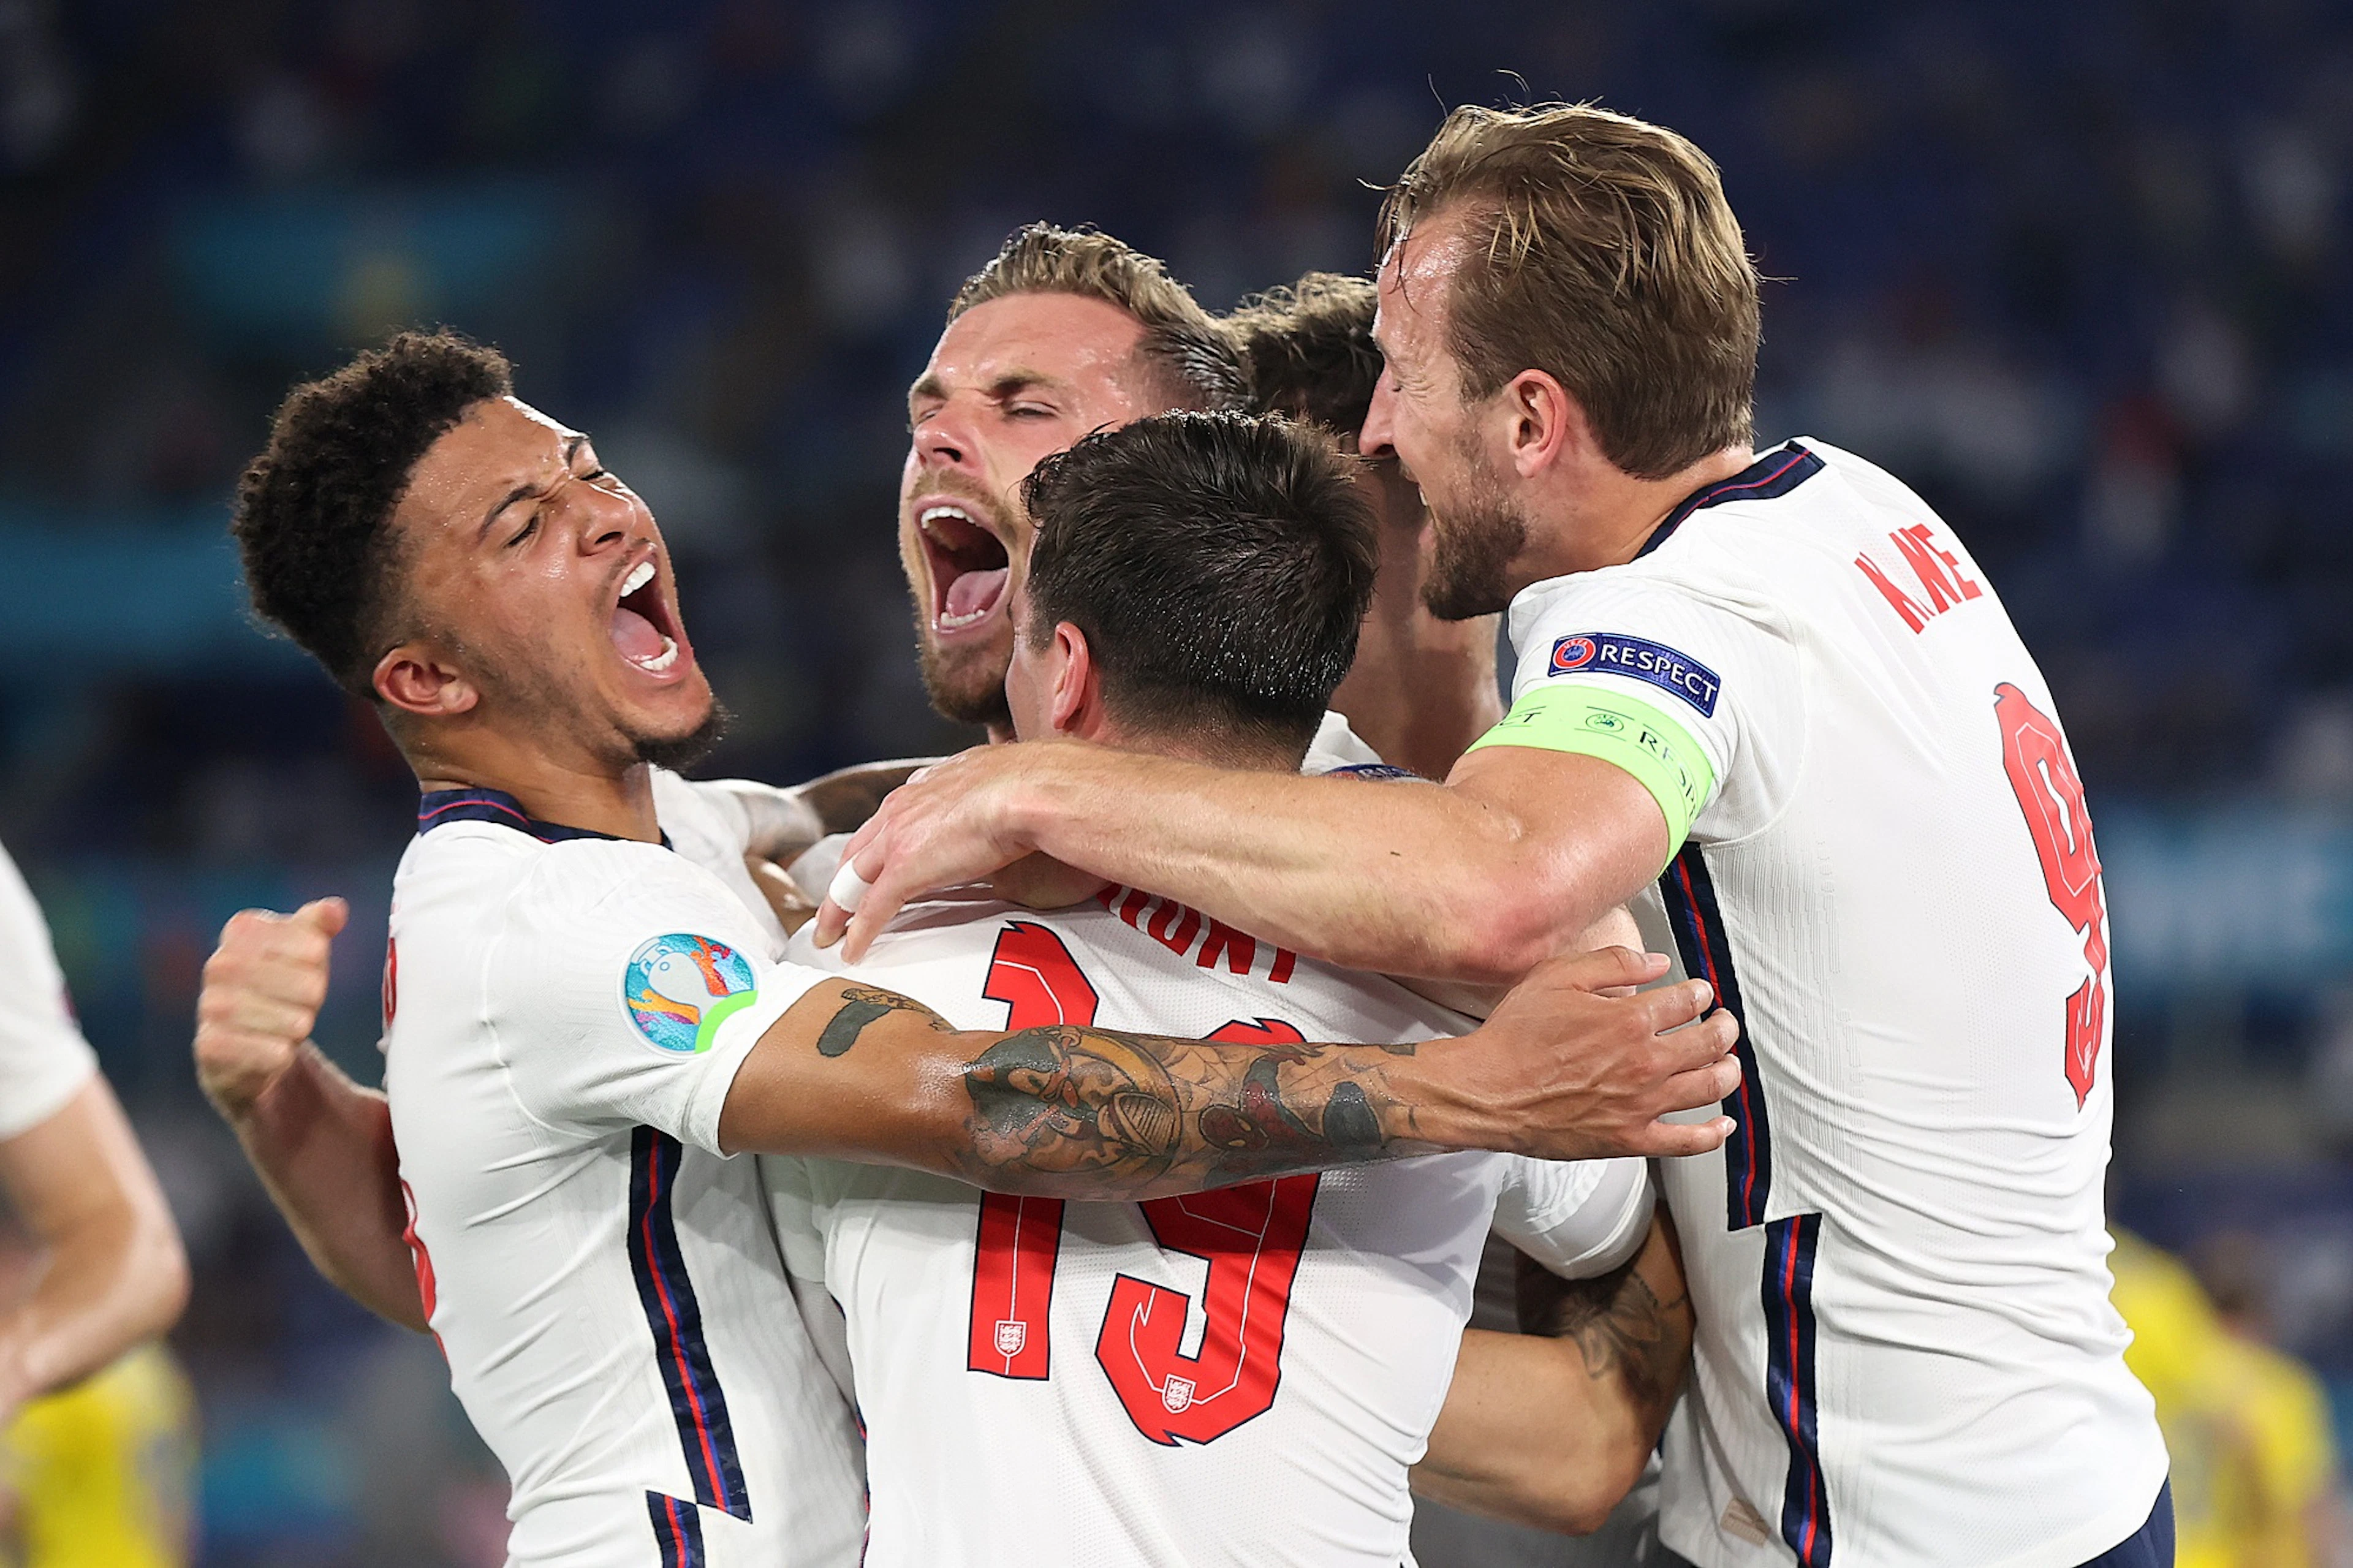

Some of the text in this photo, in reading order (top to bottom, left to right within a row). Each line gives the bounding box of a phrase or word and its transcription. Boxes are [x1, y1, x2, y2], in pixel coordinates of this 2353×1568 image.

[1854, 523, 1983, 635] KNE
[1600, 643, 1718, 702] RESPECT
[1993, 681, 2107, 1114] 9
